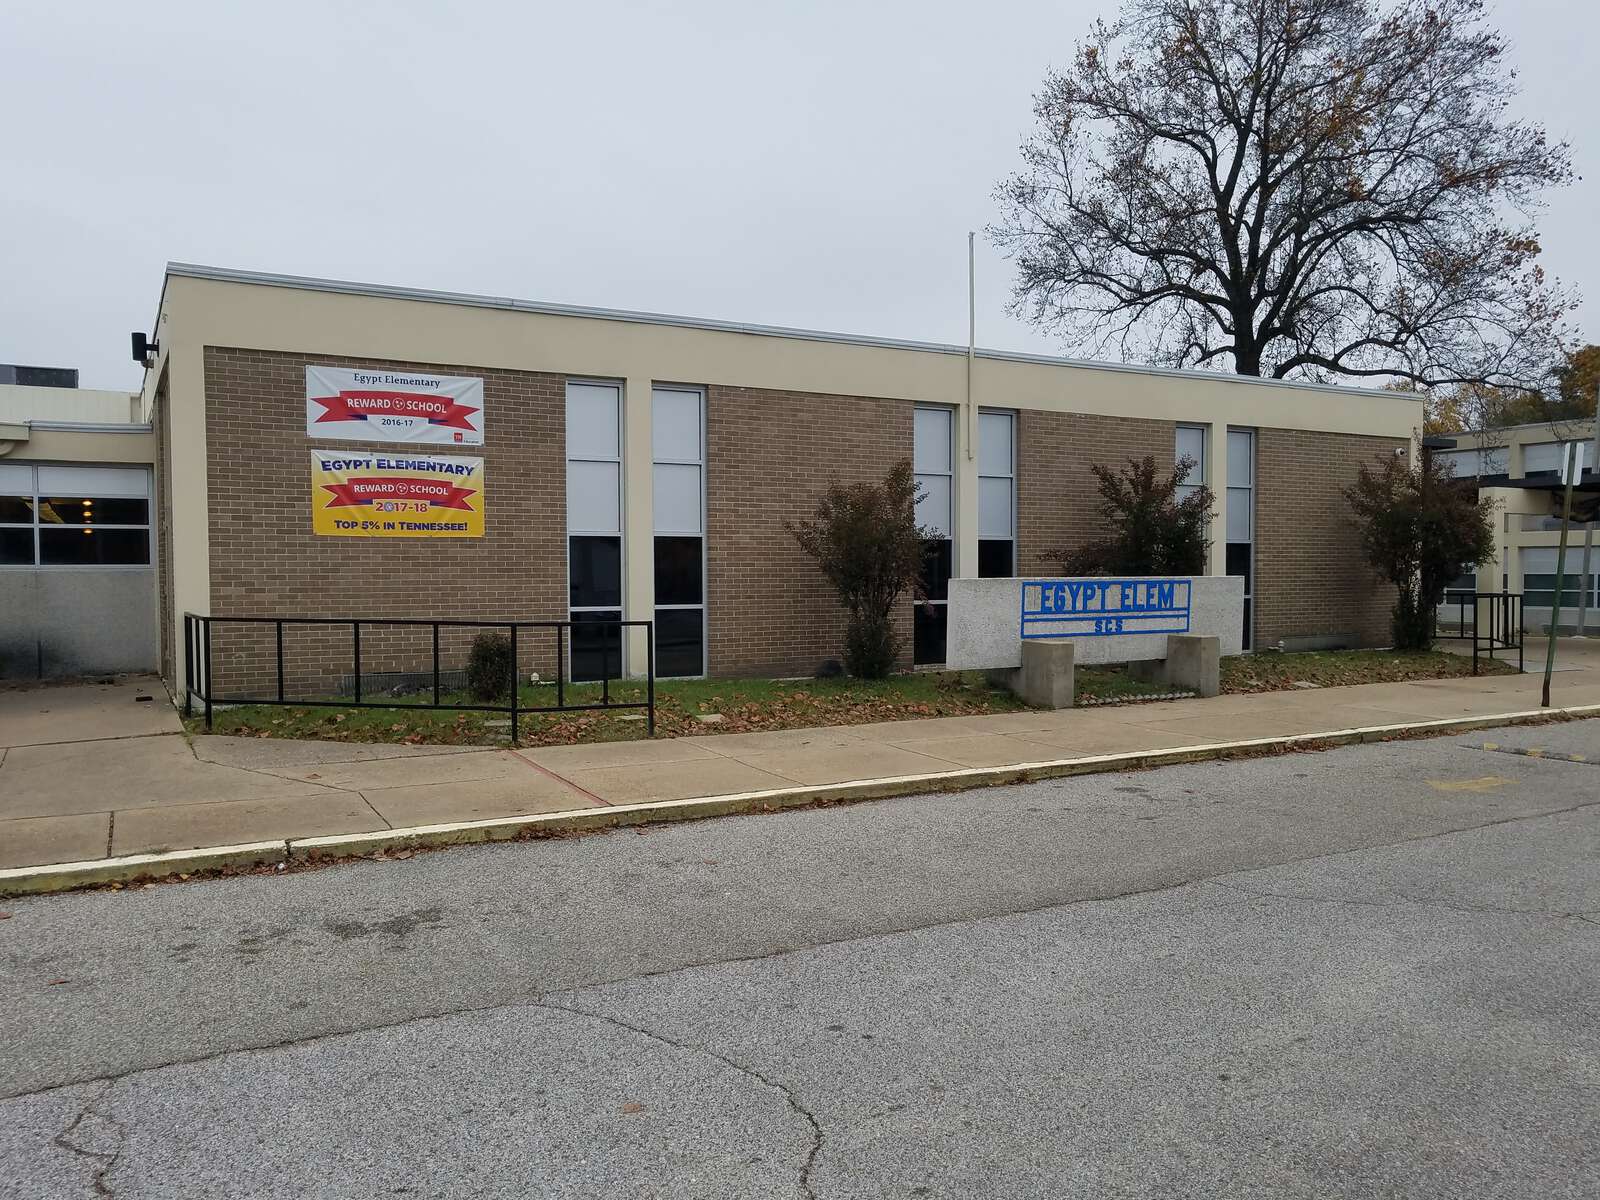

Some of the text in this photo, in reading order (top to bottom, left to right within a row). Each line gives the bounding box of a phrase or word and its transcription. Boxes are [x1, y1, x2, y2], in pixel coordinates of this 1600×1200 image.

[354, 373, 441, 389] Egypt Elementary
[347, 398, 448, 413] REWARD SCHOOL
[381, 418, 413, 427] 2016-17
[321, 459, 474, 476] EGYPT ELEMENTARY
[354, 485, 449, 495] REWARD SCHOOL
[334, 520, 468, 531] TOP 5% IN TENNESSEE!
[1041, 583, 1175, 612] EGYPT ELEM
[1094, 620, 1123, 633] SCS
